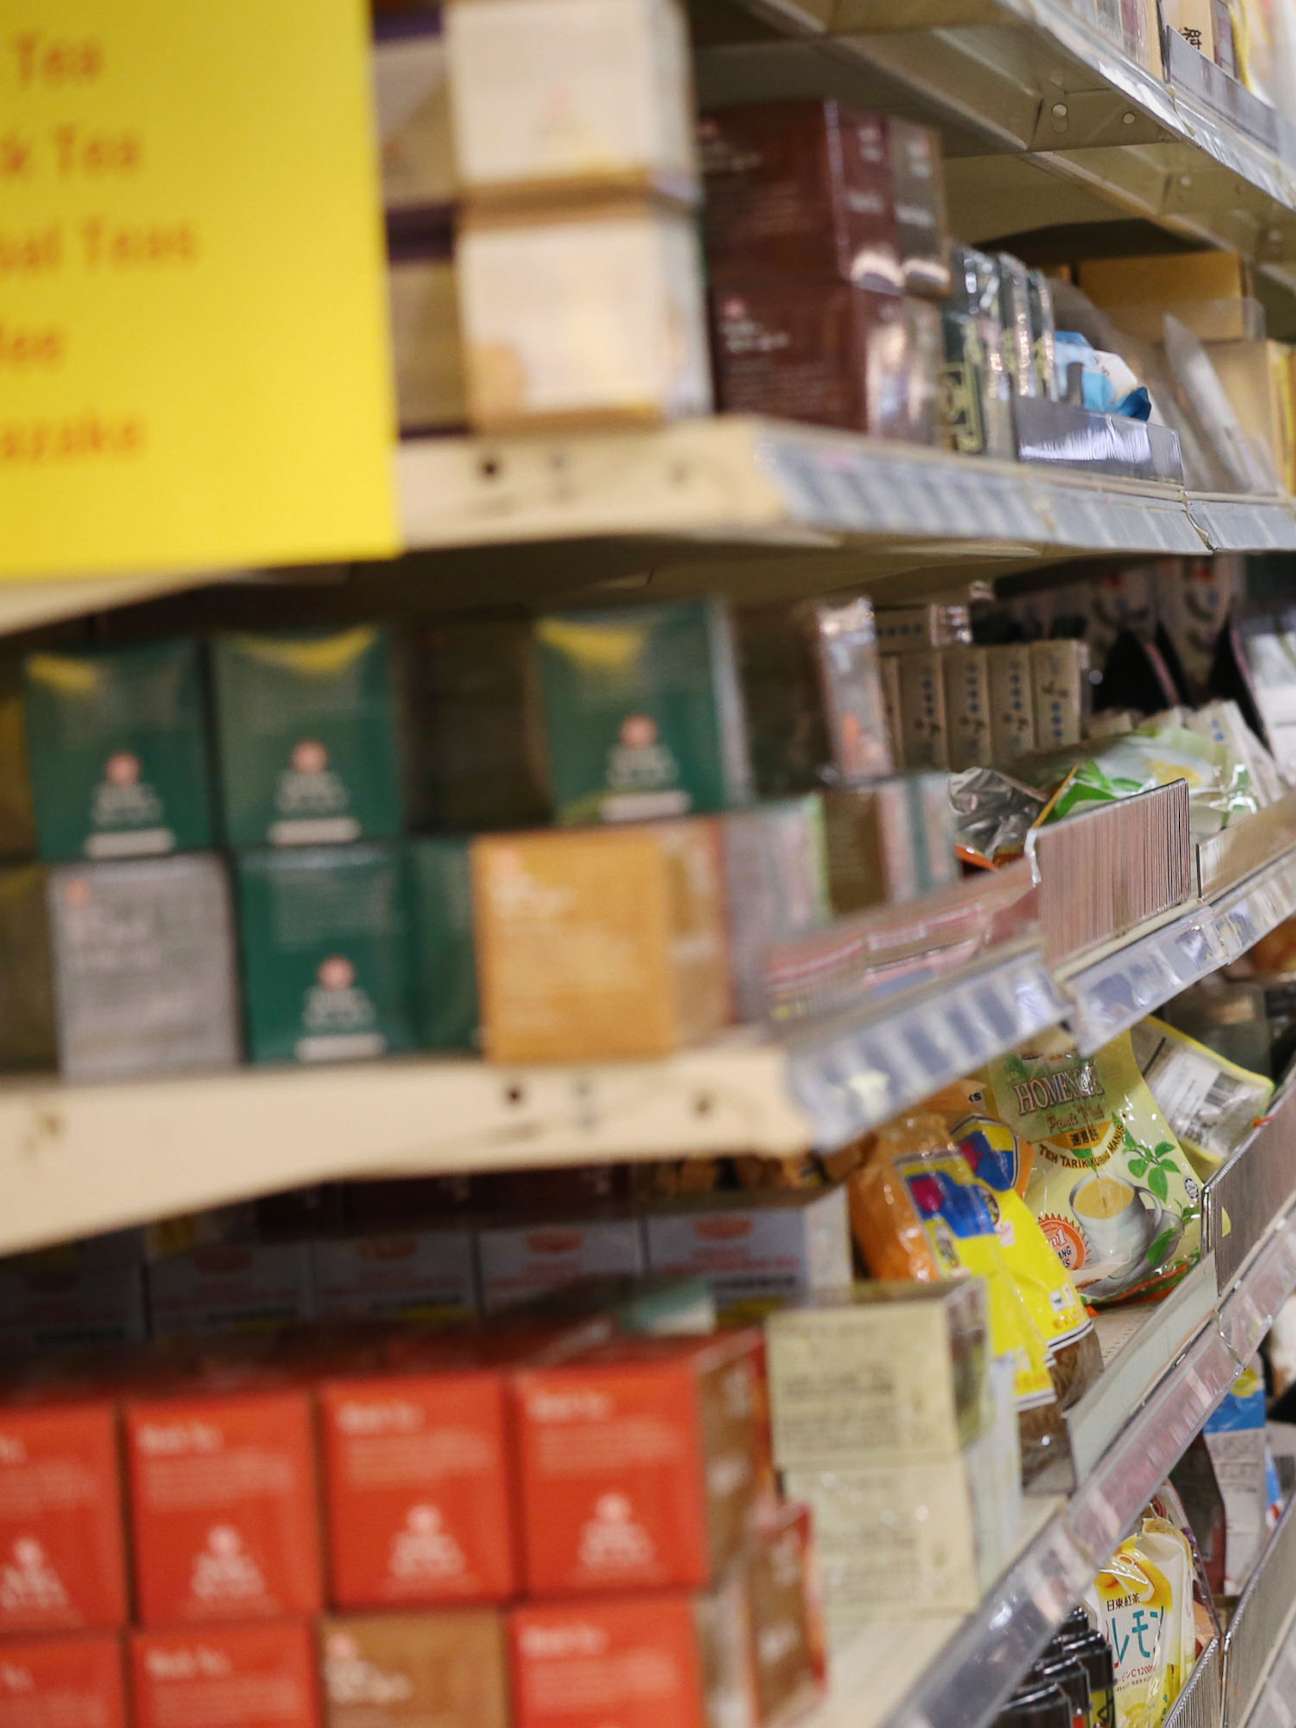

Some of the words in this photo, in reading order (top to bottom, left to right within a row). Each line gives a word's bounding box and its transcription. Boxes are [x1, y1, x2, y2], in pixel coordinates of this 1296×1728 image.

[12, 32, 105, 84] Tea
[54, 125, 142, 176] Tea
[1061, 1154, 1088, 1168] TARIK
